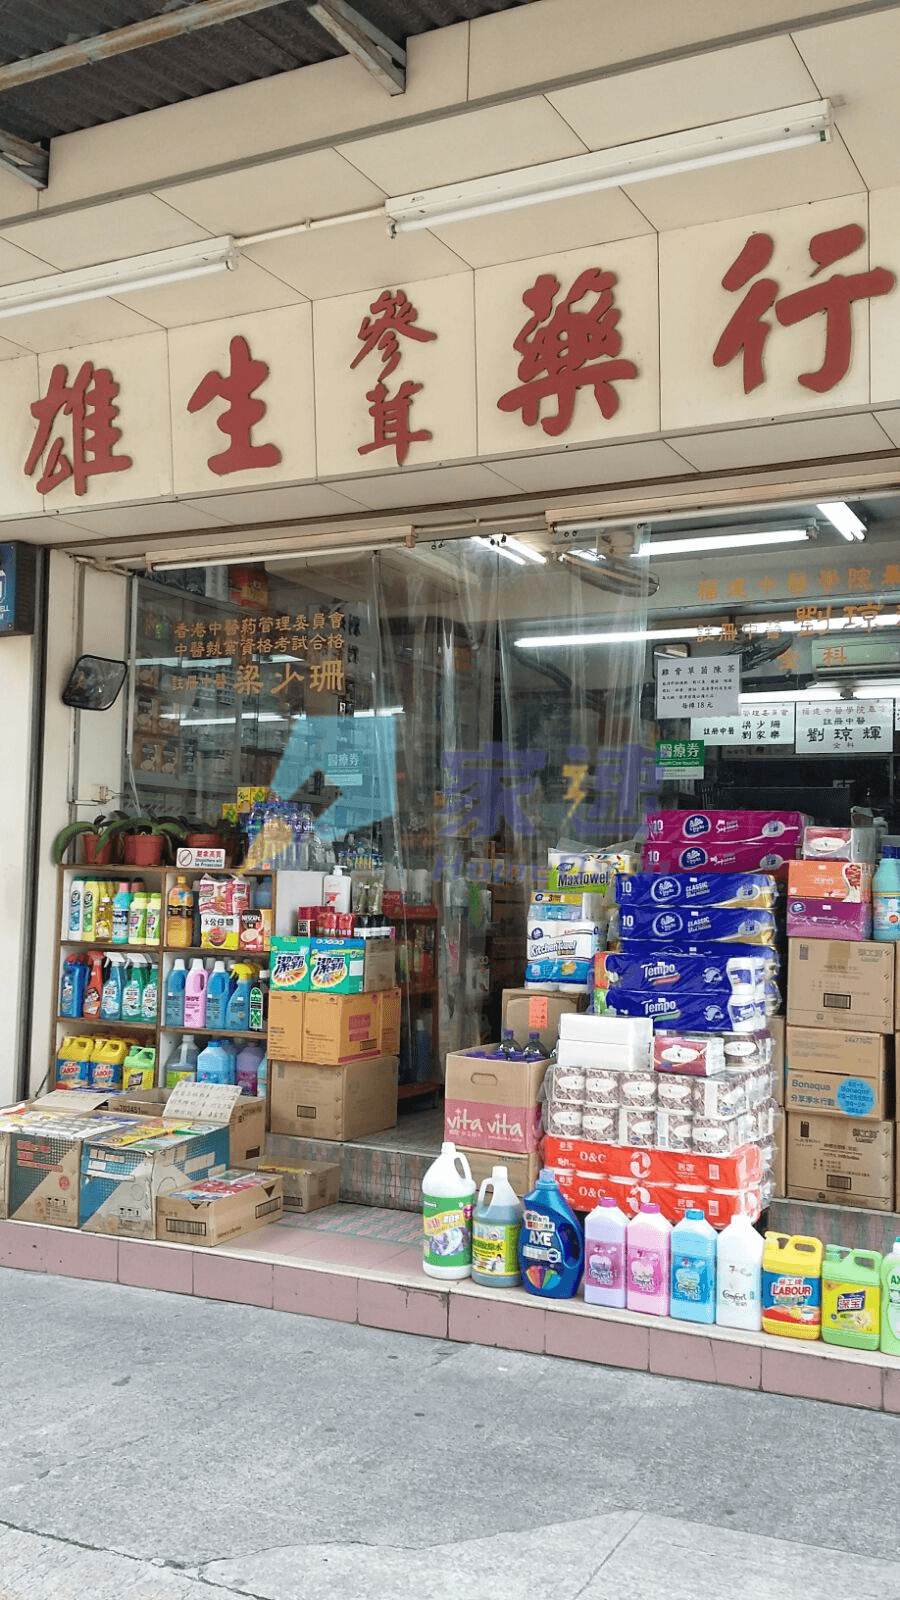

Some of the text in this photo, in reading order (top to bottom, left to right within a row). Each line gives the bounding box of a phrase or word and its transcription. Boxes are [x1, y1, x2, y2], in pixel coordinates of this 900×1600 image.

[24, 223, 895, 498] 雄生參茸藥行
[175, 633, 345, 658] 中醫執業資格考試合格
[648, 850, 660, 862] 10
[621, 881, 632, 893] 10
[622, 915, 634, 927] 10
[640, 961, 677, 978] Tempo
[641, 1000, 677, 1015] Tempo
[792, 1079, 831, 1091] Bonaqua
[446, 1108, 523, 1137] vita vita
[579, 1151, 606, 1164] O&C
[578, 1187, 606, 1199] O&C
[529, 1230, 553, 1247] AXE
[772, 1284, 811, 1296] LABOUR
